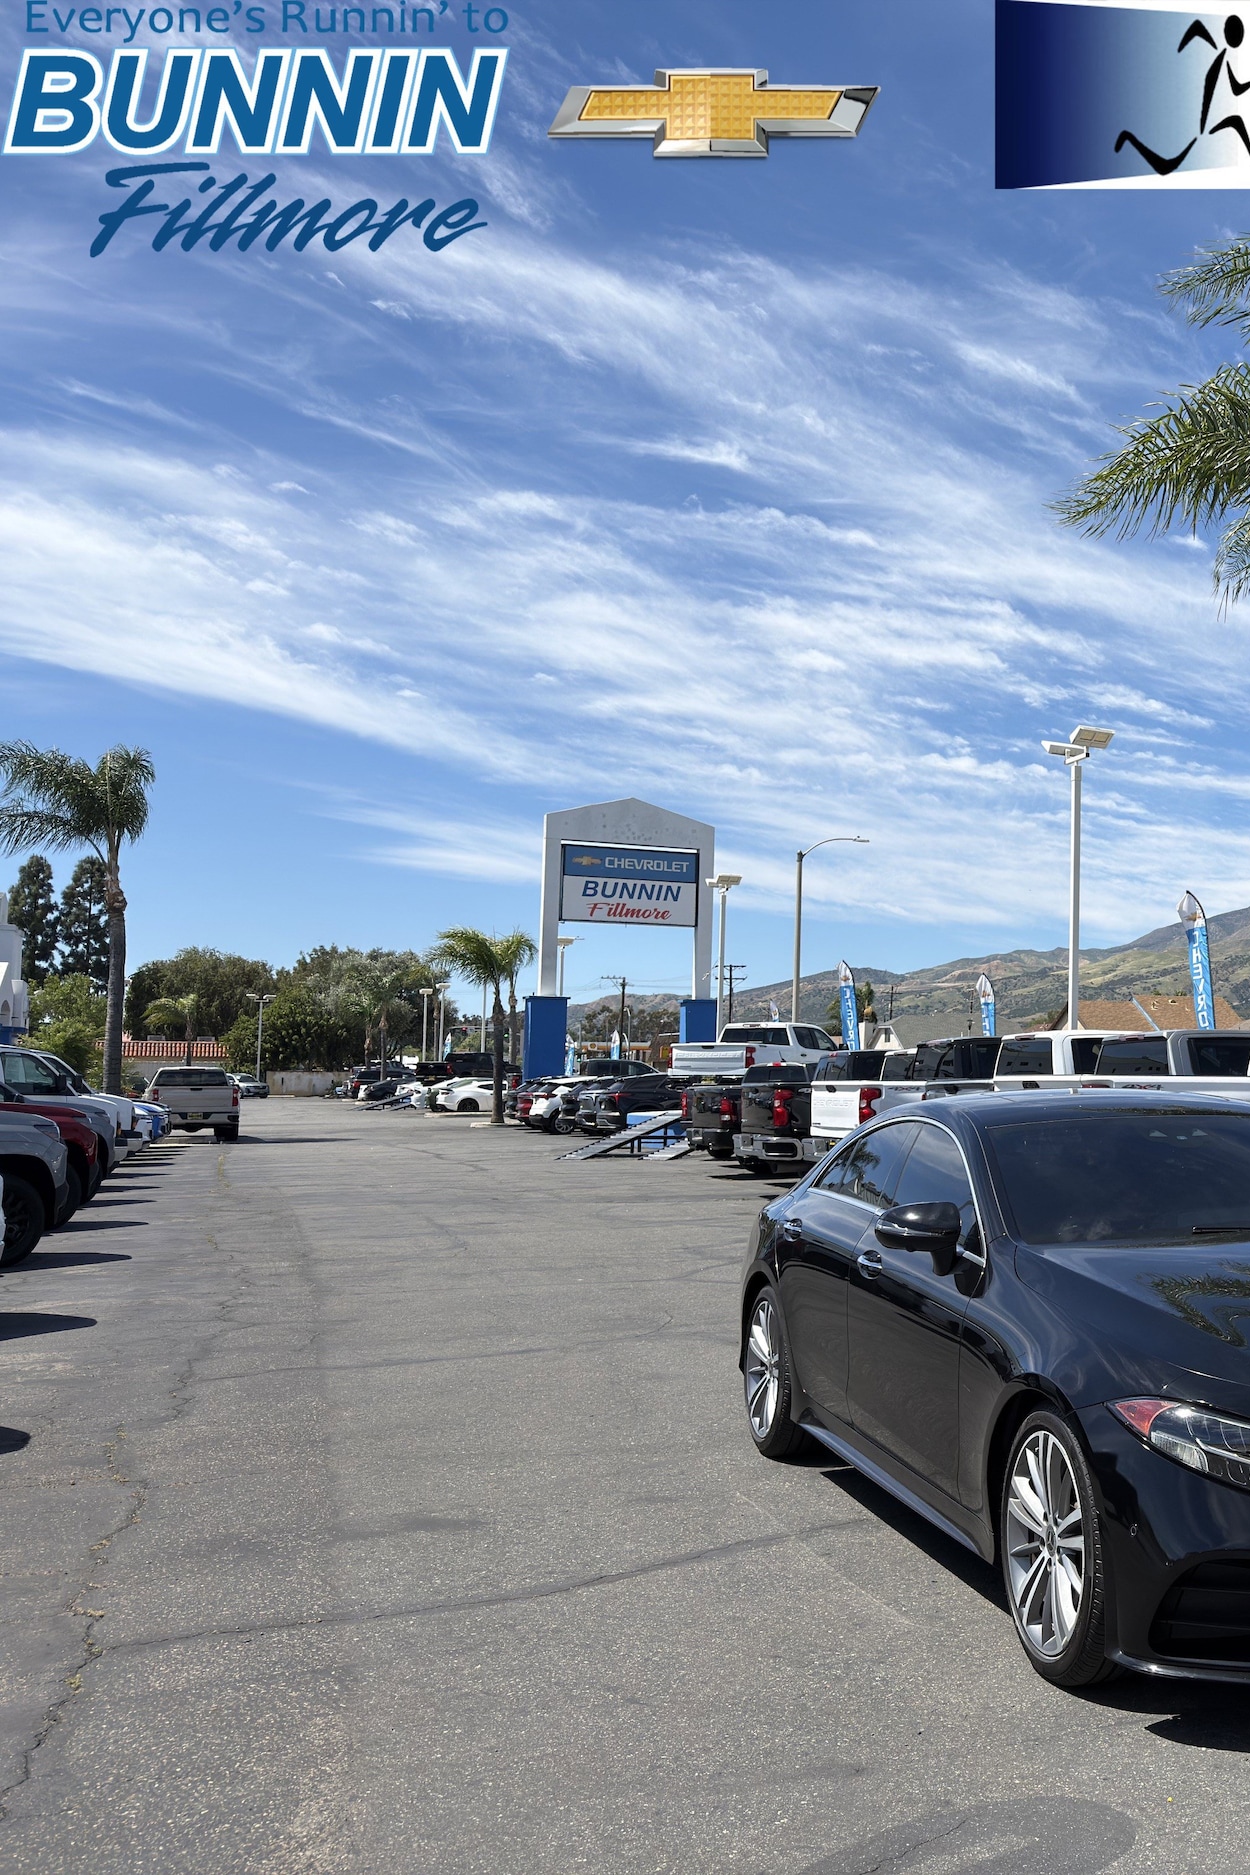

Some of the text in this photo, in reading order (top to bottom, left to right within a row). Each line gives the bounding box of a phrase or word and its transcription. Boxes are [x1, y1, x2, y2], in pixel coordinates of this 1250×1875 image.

[605, 856, 690, 873] CHEVROLET
[582, 880, 681, 902] BUNNIN
[586, 902, 672, 921] Fillmore
